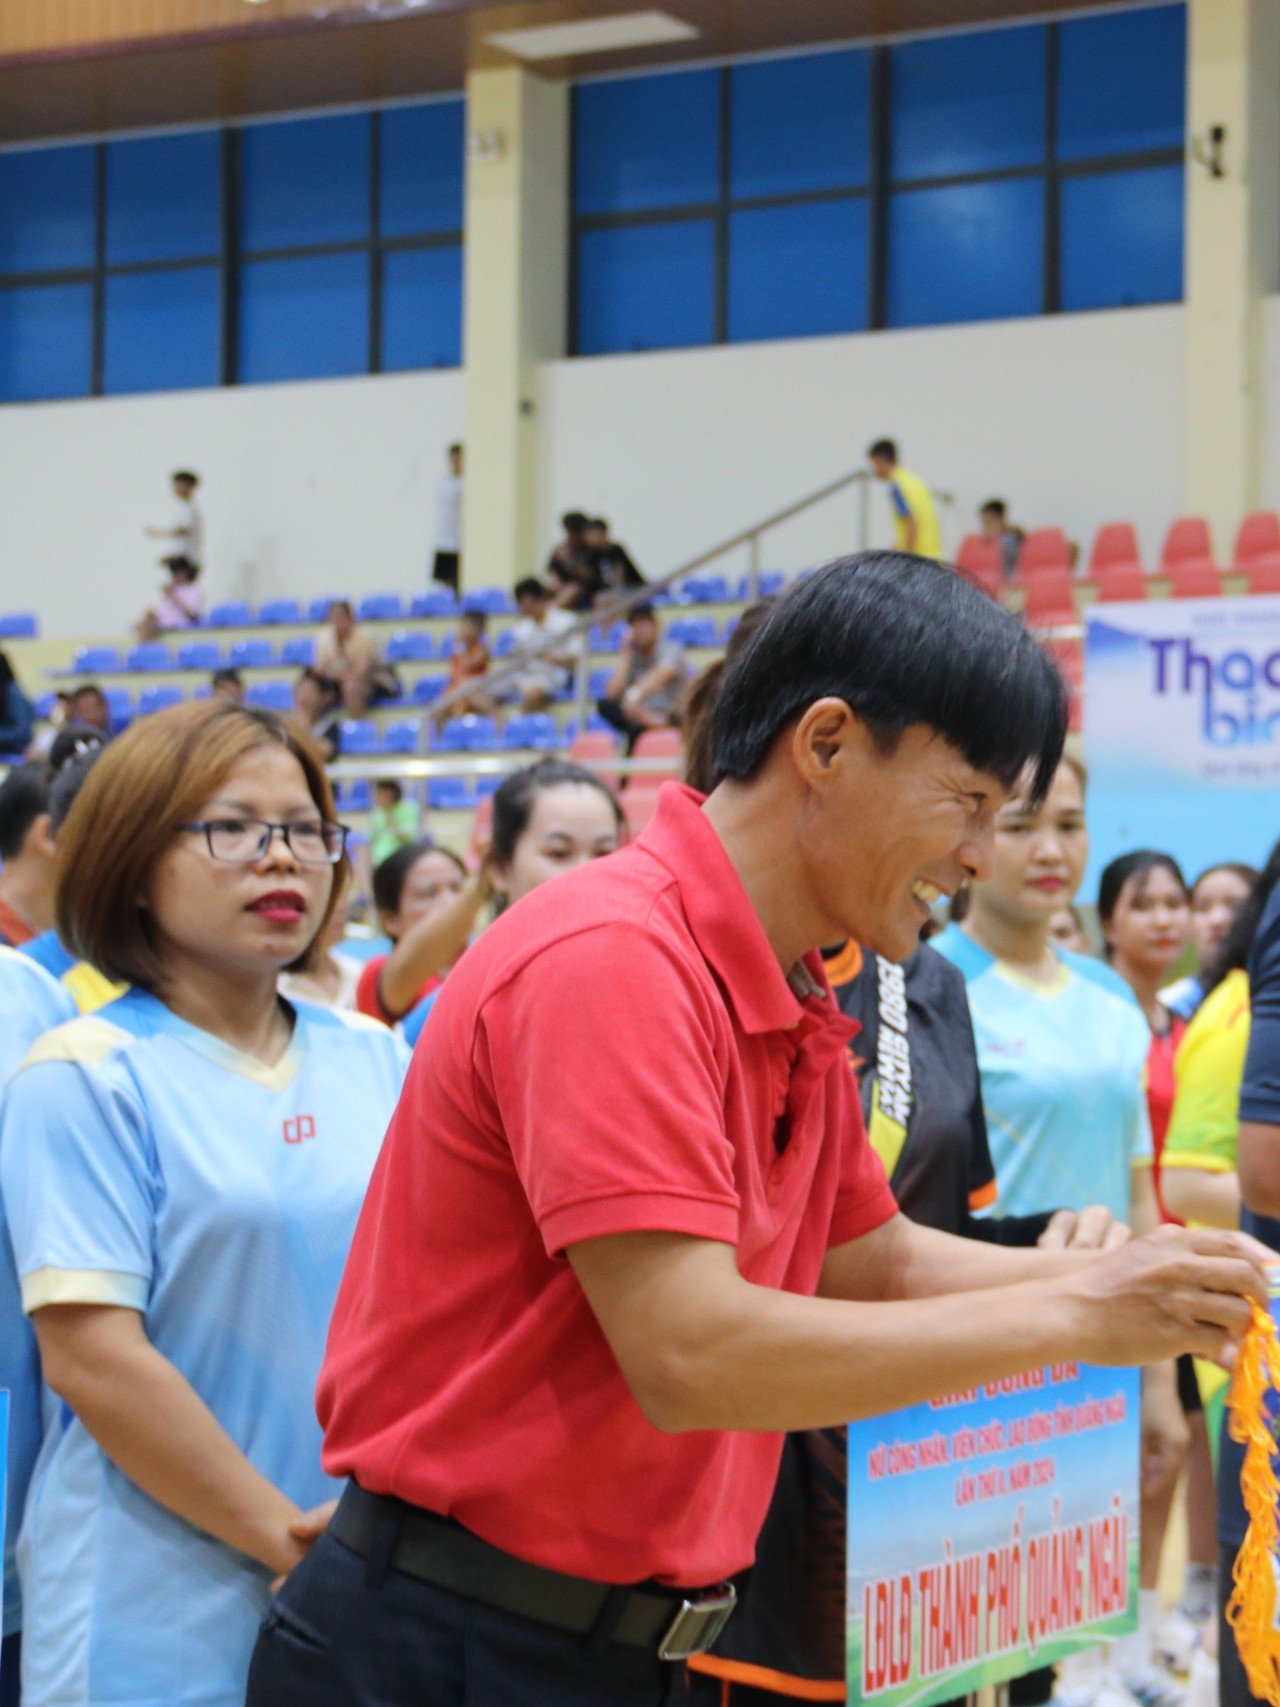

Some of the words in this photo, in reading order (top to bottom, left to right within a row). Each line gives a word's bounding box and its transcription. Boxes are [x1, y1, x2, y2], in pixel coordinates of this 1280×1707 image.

[919, 1540, 980, 1675] THÀNH
[986, 1505, 1023, 1653] PHỐ
[1027, 1499, 1083, 1651] QUẢNG
